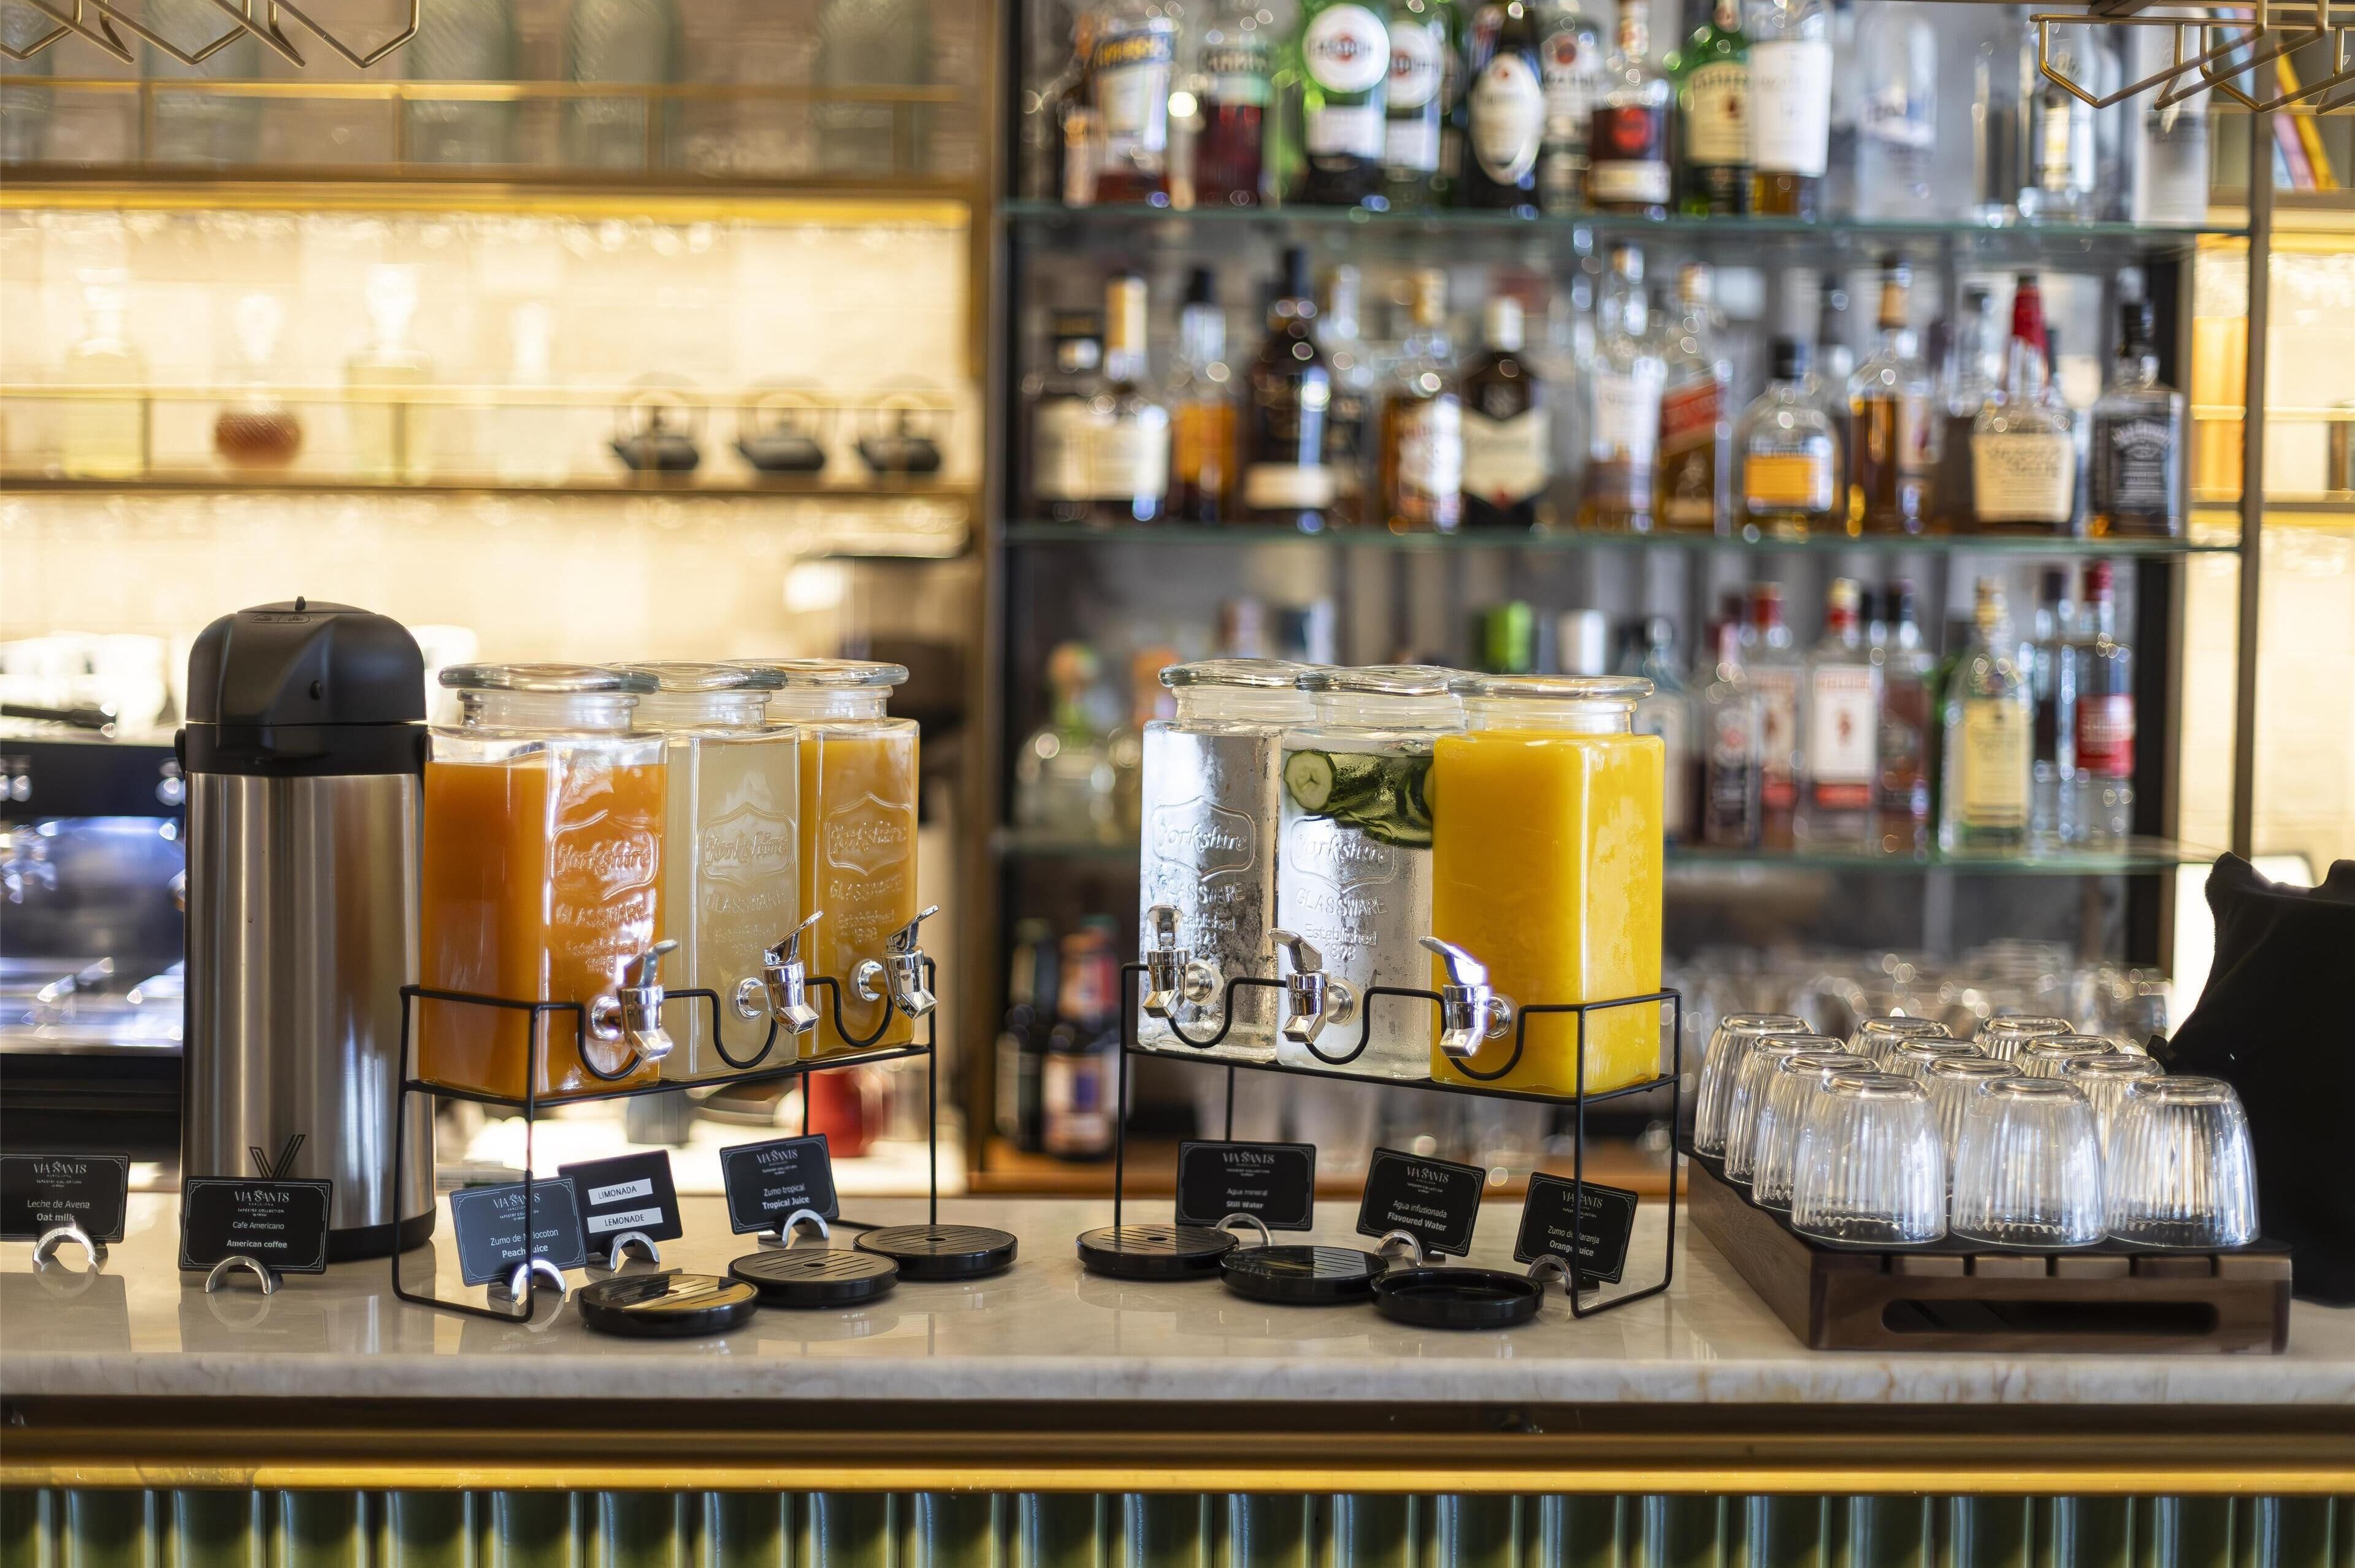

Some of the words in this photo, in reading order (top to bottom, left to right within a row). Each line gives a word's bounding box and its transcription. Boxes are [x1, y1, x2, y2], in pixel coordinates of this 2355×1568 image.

[1158, 823, 1247, 853] Yorkshire
[557, 839, 651, 877] Yorkshire
[1296, 888, 1388, 917] GLASSWARE
[1304, 924, 1377, 945] Established
[234, 1191, 251, 1202] VIA
[253, 1190, 289, 1203] SANTS
[598, 1186, 637, 1199] LIMONADA
[764, 1188, 781, 1197] Zumo
[783, 1183, 805, 1193] tropical
[27, 1199, 50, 1208] Leche
[64, 1200, 90, 1209] Avena
[493, 1198, 510, 1209] VIA
[762, 1198, 790, 1210] Tropical
[792, 1196, 810, 1206] Juice
[1393, 1199, 1409, 1210] Agua
[1411, 1203, 1447, 1218] infusionada
[37, 1213, 53, 1222] Oat
[55, 1213, 74, 1222] milk
[605, 1214, 645, 1226] LEMONADE
[1387, 1212, 1423, 1226] Flavoured
[1424, 1219, 1447, 1231] Water
[1547, 1225, 1565, 1236] Zumo
[490, 1237, 511, 1246] Zumo
[502, 1247, 526, 1258] Peach
[533, 1244, 549, 1253] uice
[1579, 1246, 1594, 1256] uice
